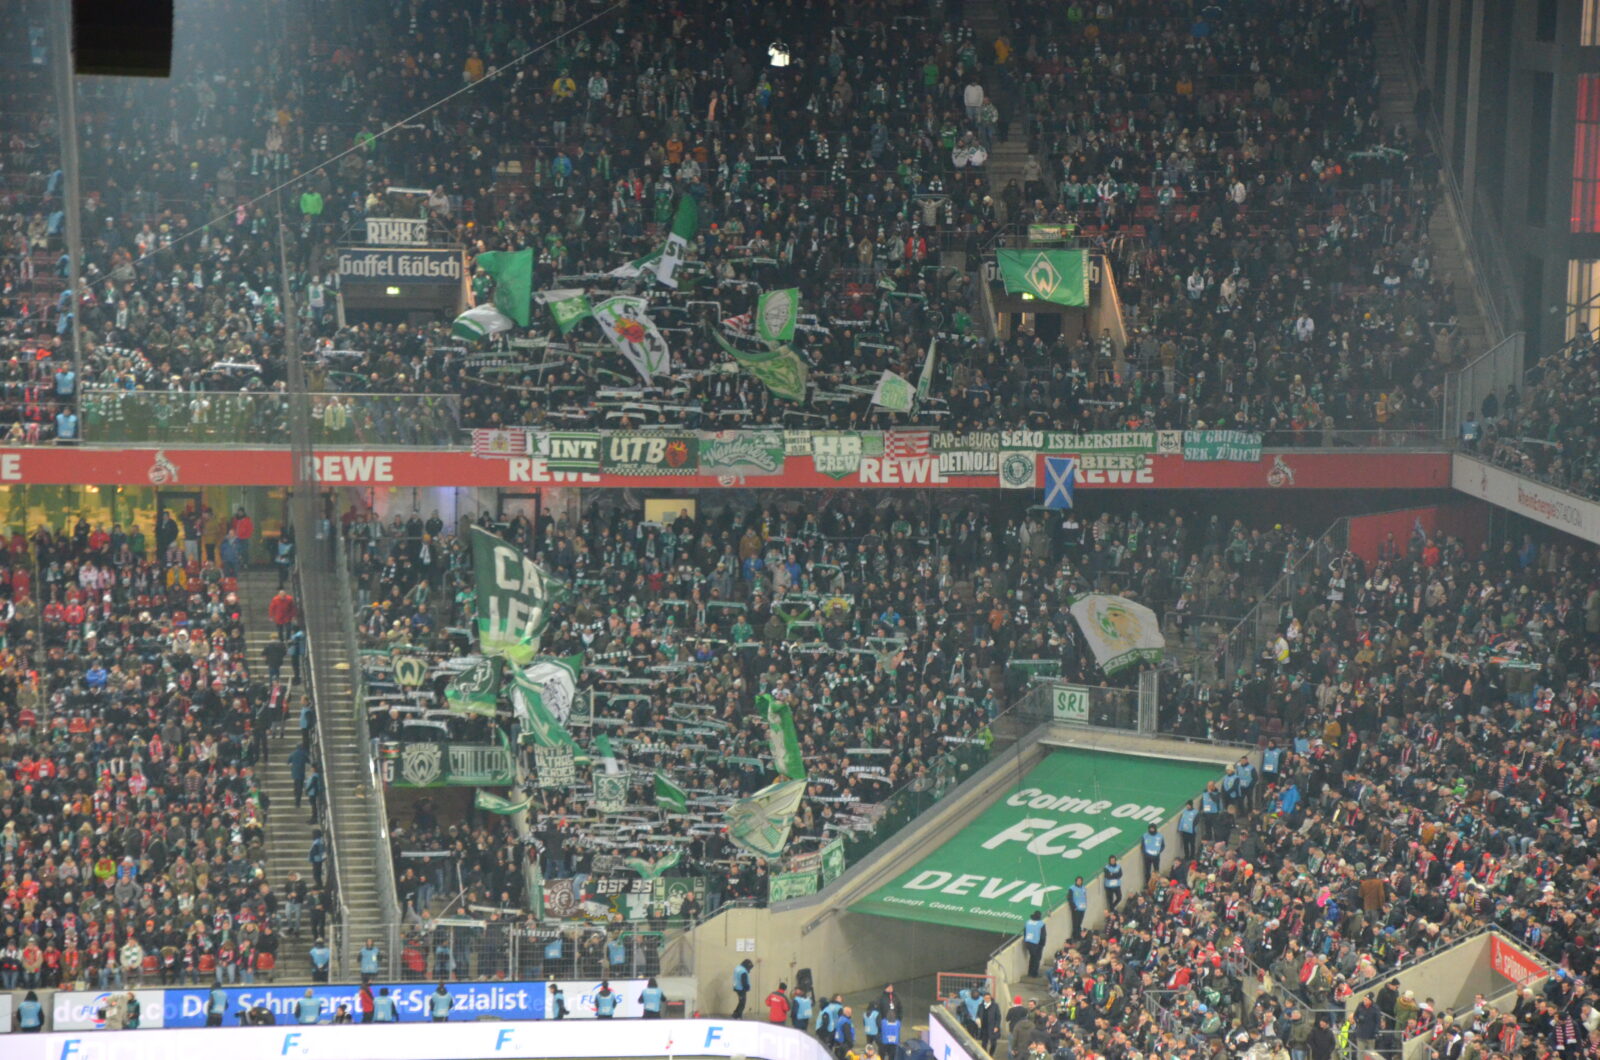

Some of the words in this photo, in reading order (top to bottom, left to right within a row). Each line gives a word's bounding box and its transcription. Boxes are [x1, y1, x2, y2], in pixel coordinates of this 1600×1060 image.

[339, 254, 395, 277] Gaffel
[398, 255, 460, 280] Kölsch
[550, 440, 597, 459] INT
[1001, 431, 1044, 448] SEKO
[1047, 432, 1153, 449] ISELERSHEIM
[610, 437, 667, 464] UTB
[1215, 443, 1260, 462] ZÜRICH
[303, 456, 393, 482] REWE
[816, 455, 861, 472] CREW
[940, 452, 998, 472] DETMOLD
[1081, 455, 1135, 469] BIER
[1057, 691, 1085, 713] SRL
[1007, 788, 1112, 815] Come
[1111, 803, 1166, 824] on,
[981, 818, 1123, 859] FC!
[902, 870, 1063, 907] DEVK
